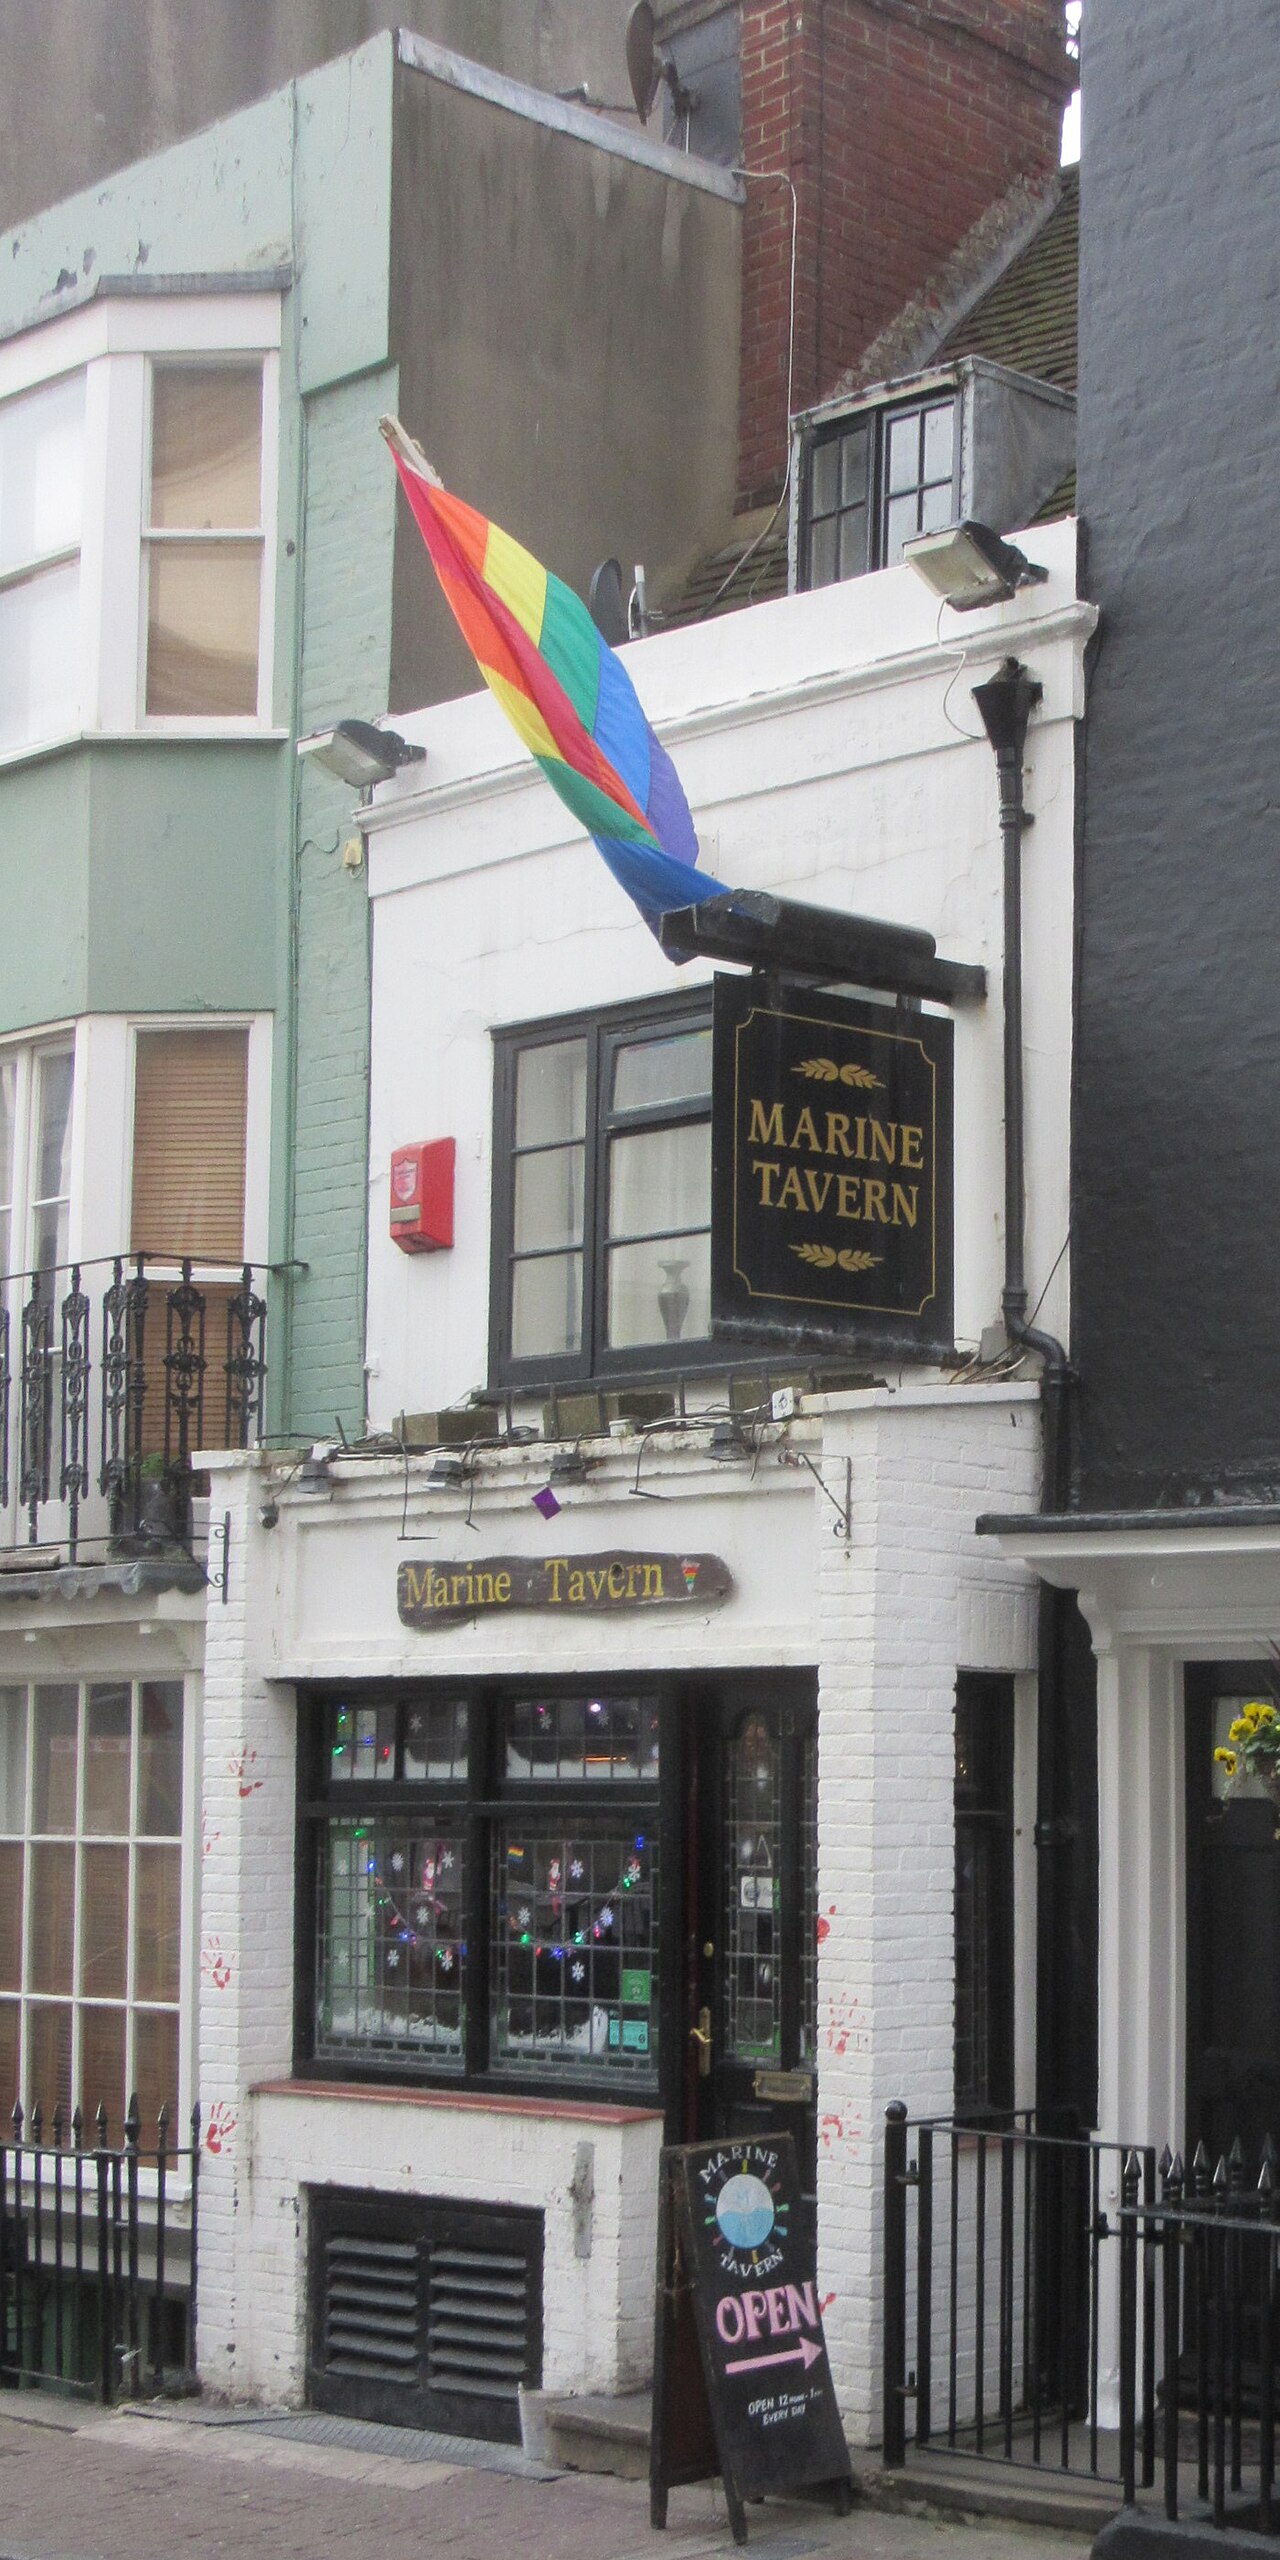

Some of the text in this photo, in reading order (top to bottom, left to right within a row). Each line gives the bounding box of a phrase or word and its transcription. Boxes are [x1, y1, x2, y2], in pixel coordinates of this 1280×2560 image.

[748, 1099, 924, 1169] MARINE
[752, 1159, 919, 1229] TAVERN
[404, 1558, 665, 1608] Marine Tavern
[699, 2145, 779, 2184] MARINE
[720, 2248, 784, 2278] TAVERN
[715, 2280, 820, 2345] OPEN
[748, 2397, 775, 2416] OPEN
[763, 2403, 806, 2426] EVERY DAY
